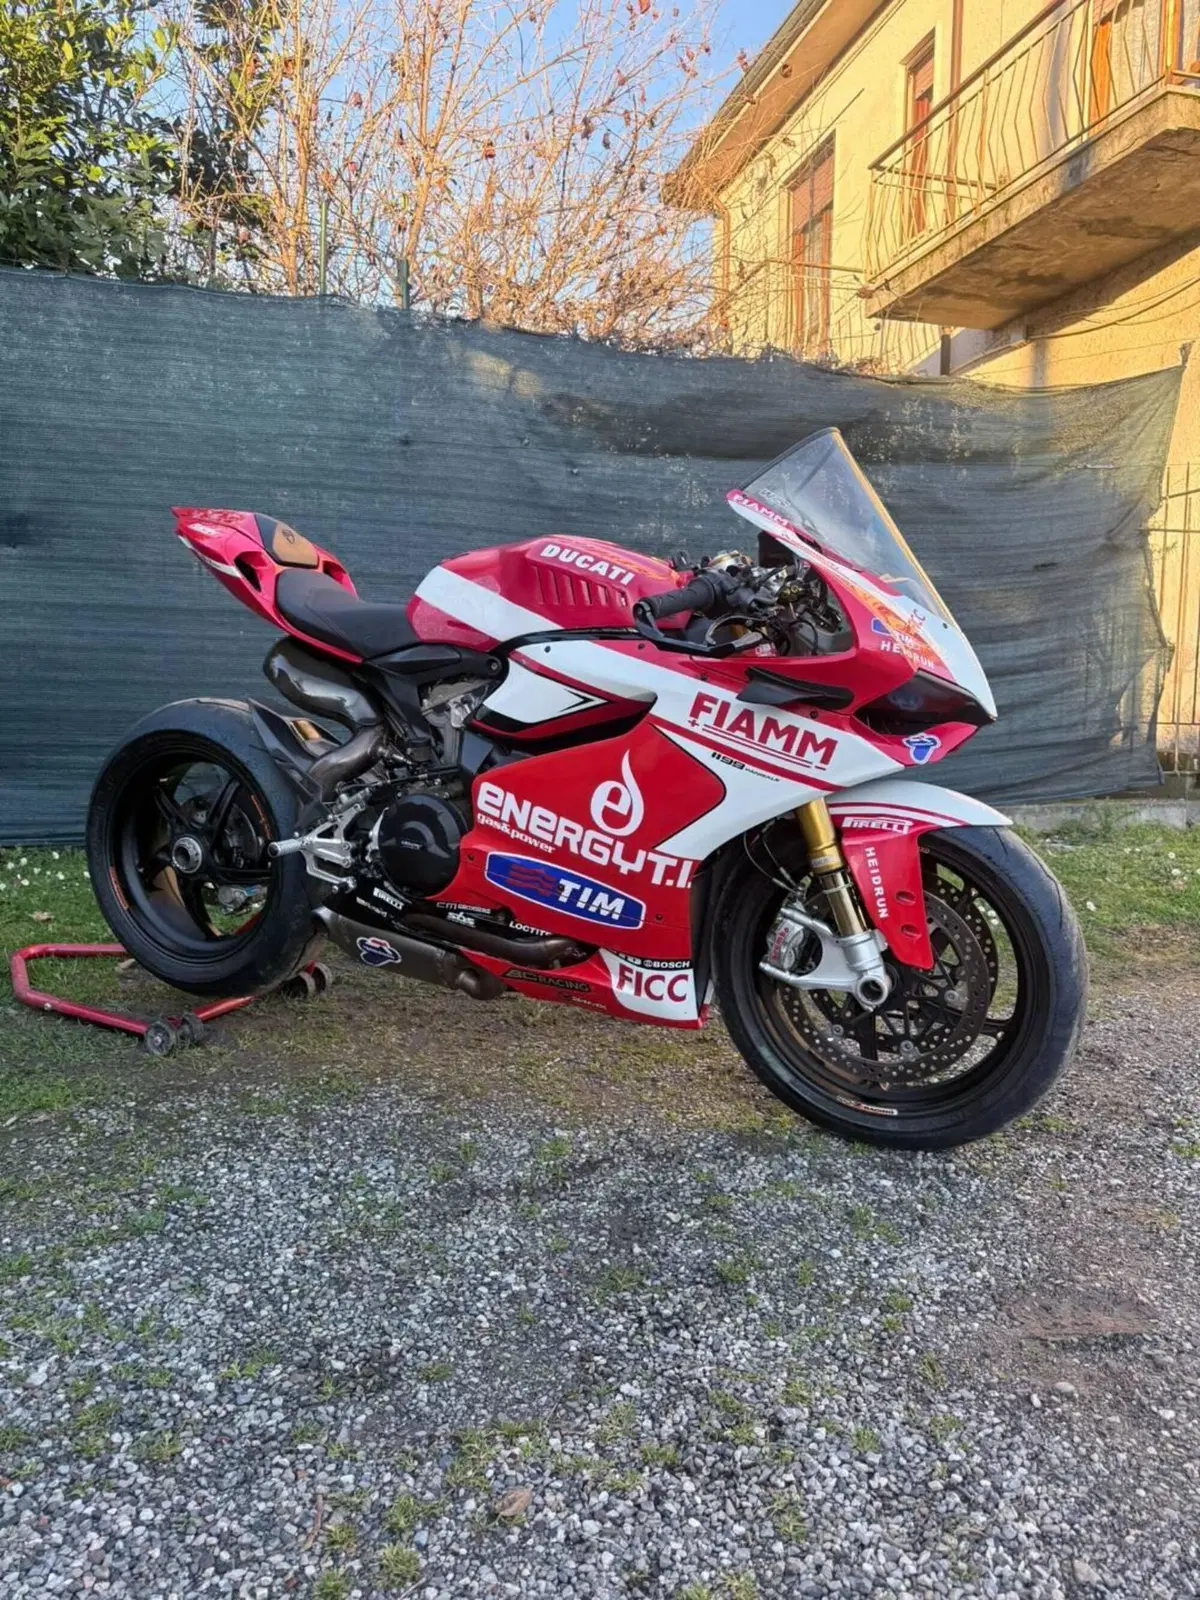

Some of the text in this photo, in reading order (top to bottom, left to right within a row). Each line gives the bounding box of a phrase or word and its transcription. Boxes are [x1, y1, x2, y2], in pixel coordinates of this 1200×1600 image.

[540, 543, 636, 586] DUCATI
[689, 691, 838, 765] FIAMM
[711, 751, 746, 770] 1199
[476, 812, 556, 854] gas&power
[842, 816, 914, 835] PIRELLI
[554, 878, 626, 920] TIM
[864, 846, 889, 919] HEIDRUN
[616, 963, 690, 1003] FICC
[652, 960, 691, 969] BOSCH
